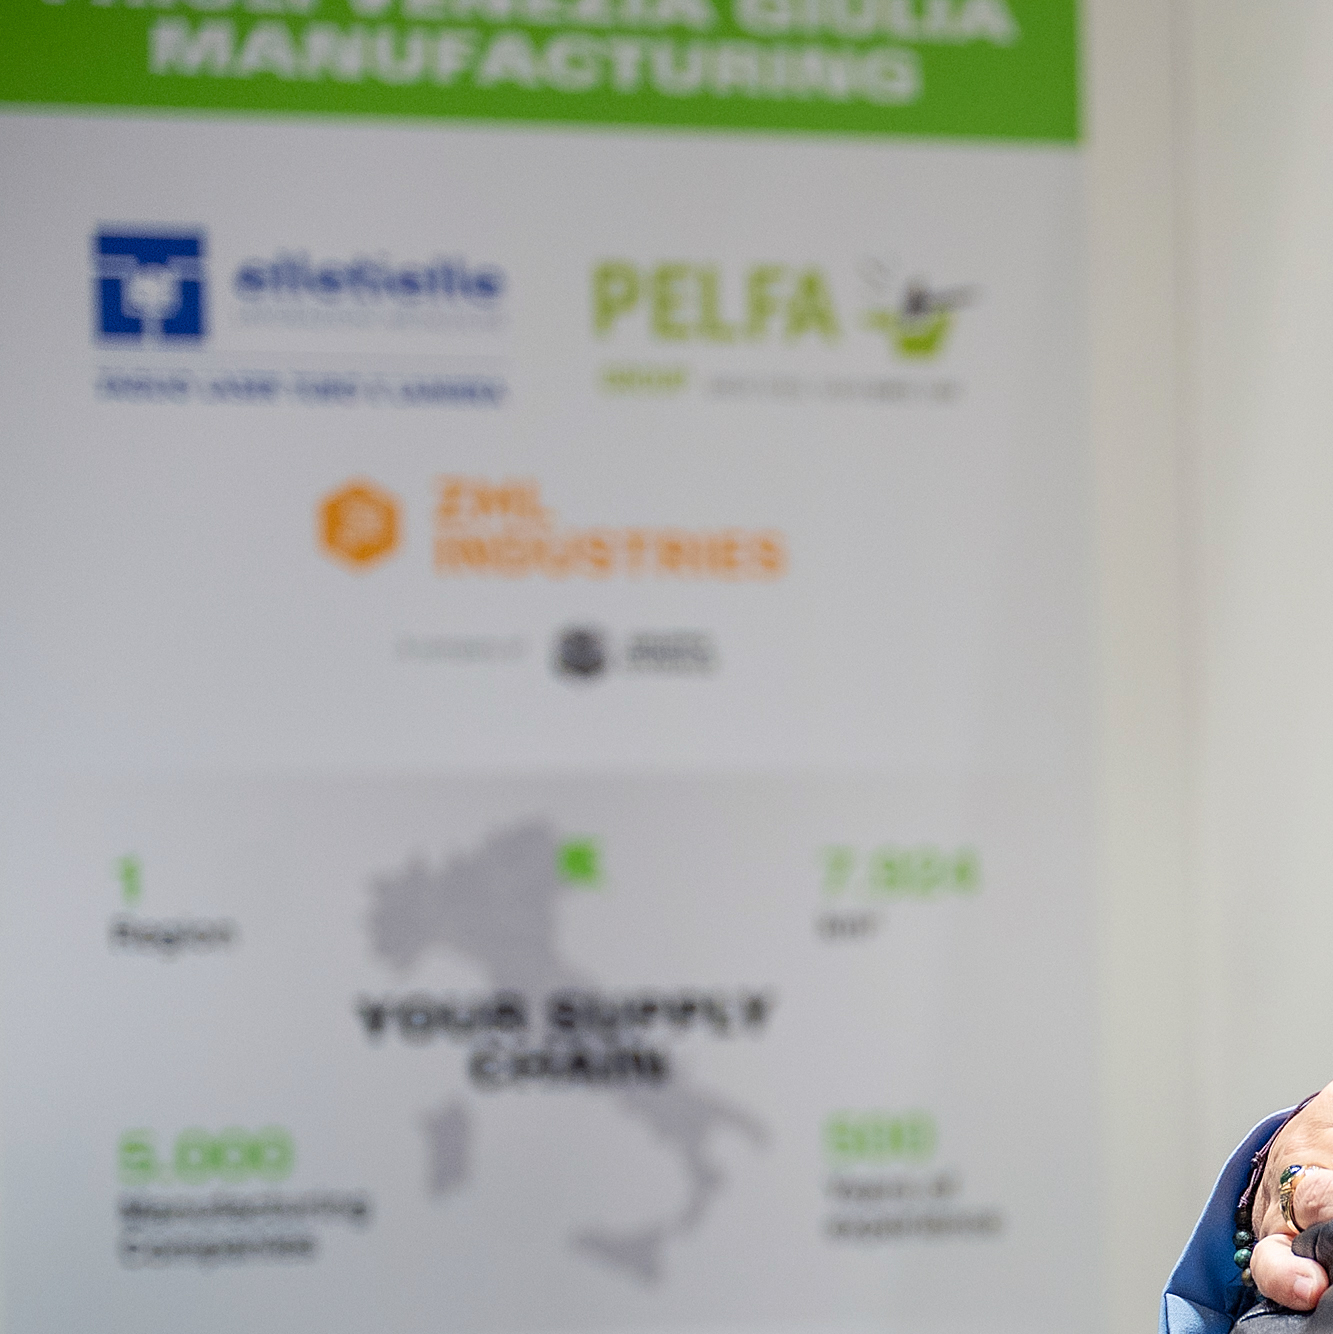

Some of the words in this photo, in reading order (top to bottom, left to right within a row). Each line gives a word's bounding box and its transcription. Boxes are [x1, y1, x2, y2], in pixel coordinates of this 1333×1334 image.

[149, 17, 923, 107] MANUFACTURING
[594, 257, 842, 346] PELFA
[434, 526, 786, 580] INDUSTRIES
[358, 988, 530, 1045] YOUR
[548, 984, 775, 1042] SUPPLY
[468, 1044, 672, 1092] CHAIN
[116, 1127, 297, 1186] 5.000
